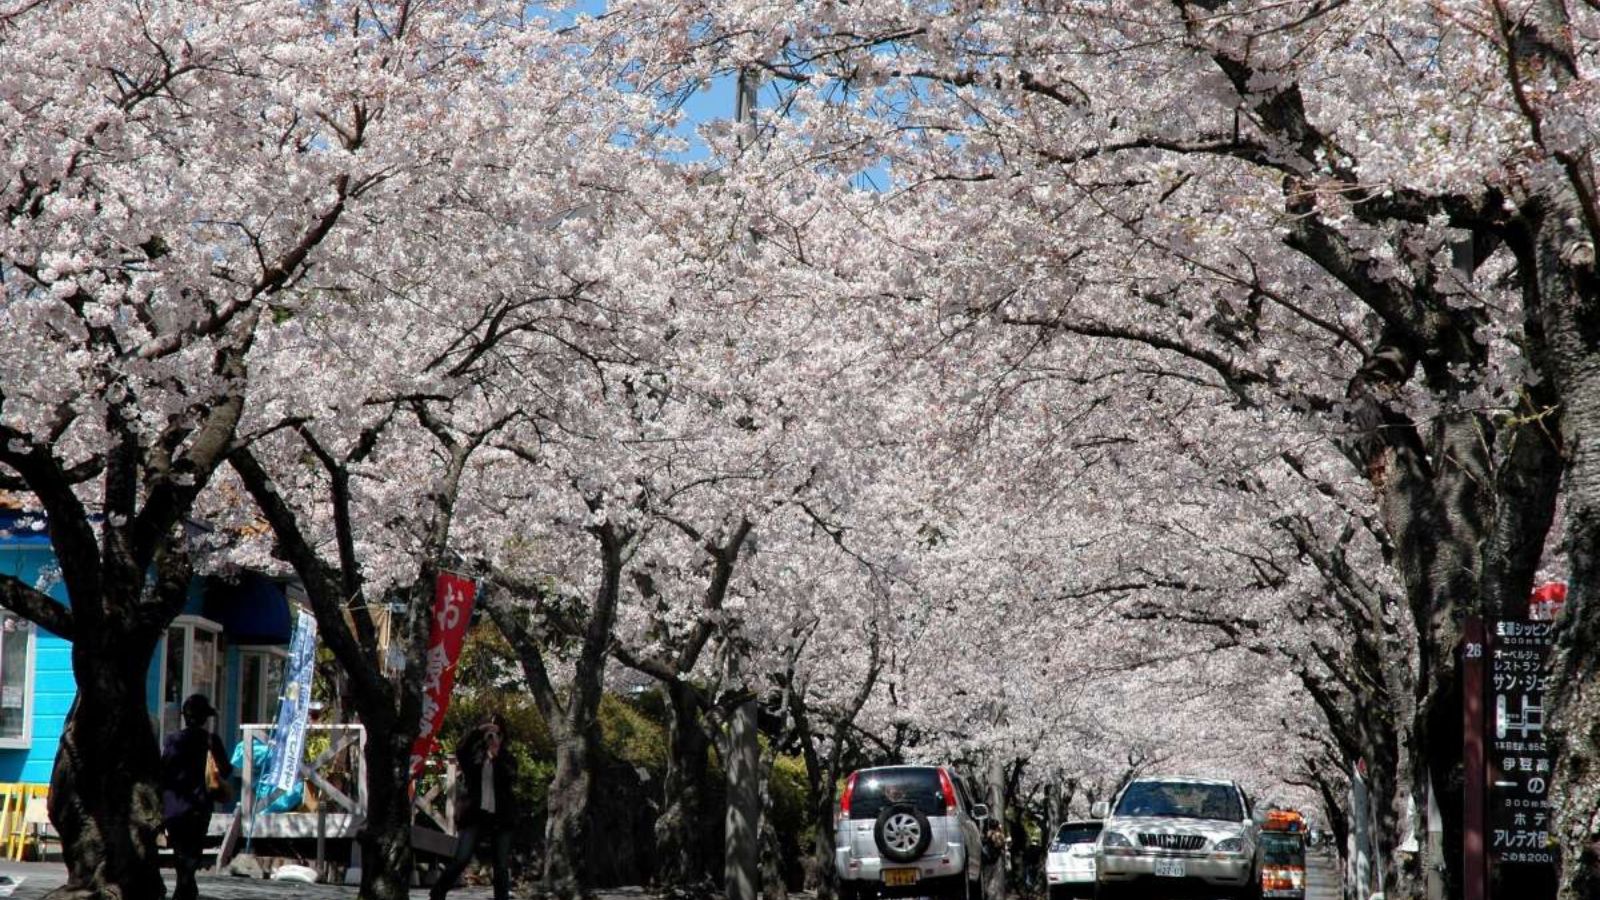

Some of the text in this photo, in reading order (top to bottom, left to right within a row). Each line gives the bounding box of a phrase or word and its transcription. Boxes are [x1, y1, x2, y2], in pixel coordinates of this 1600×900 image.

[1494, 661, 1540, 671] レストラン
[1501, 852, 1553, 863] この先200
